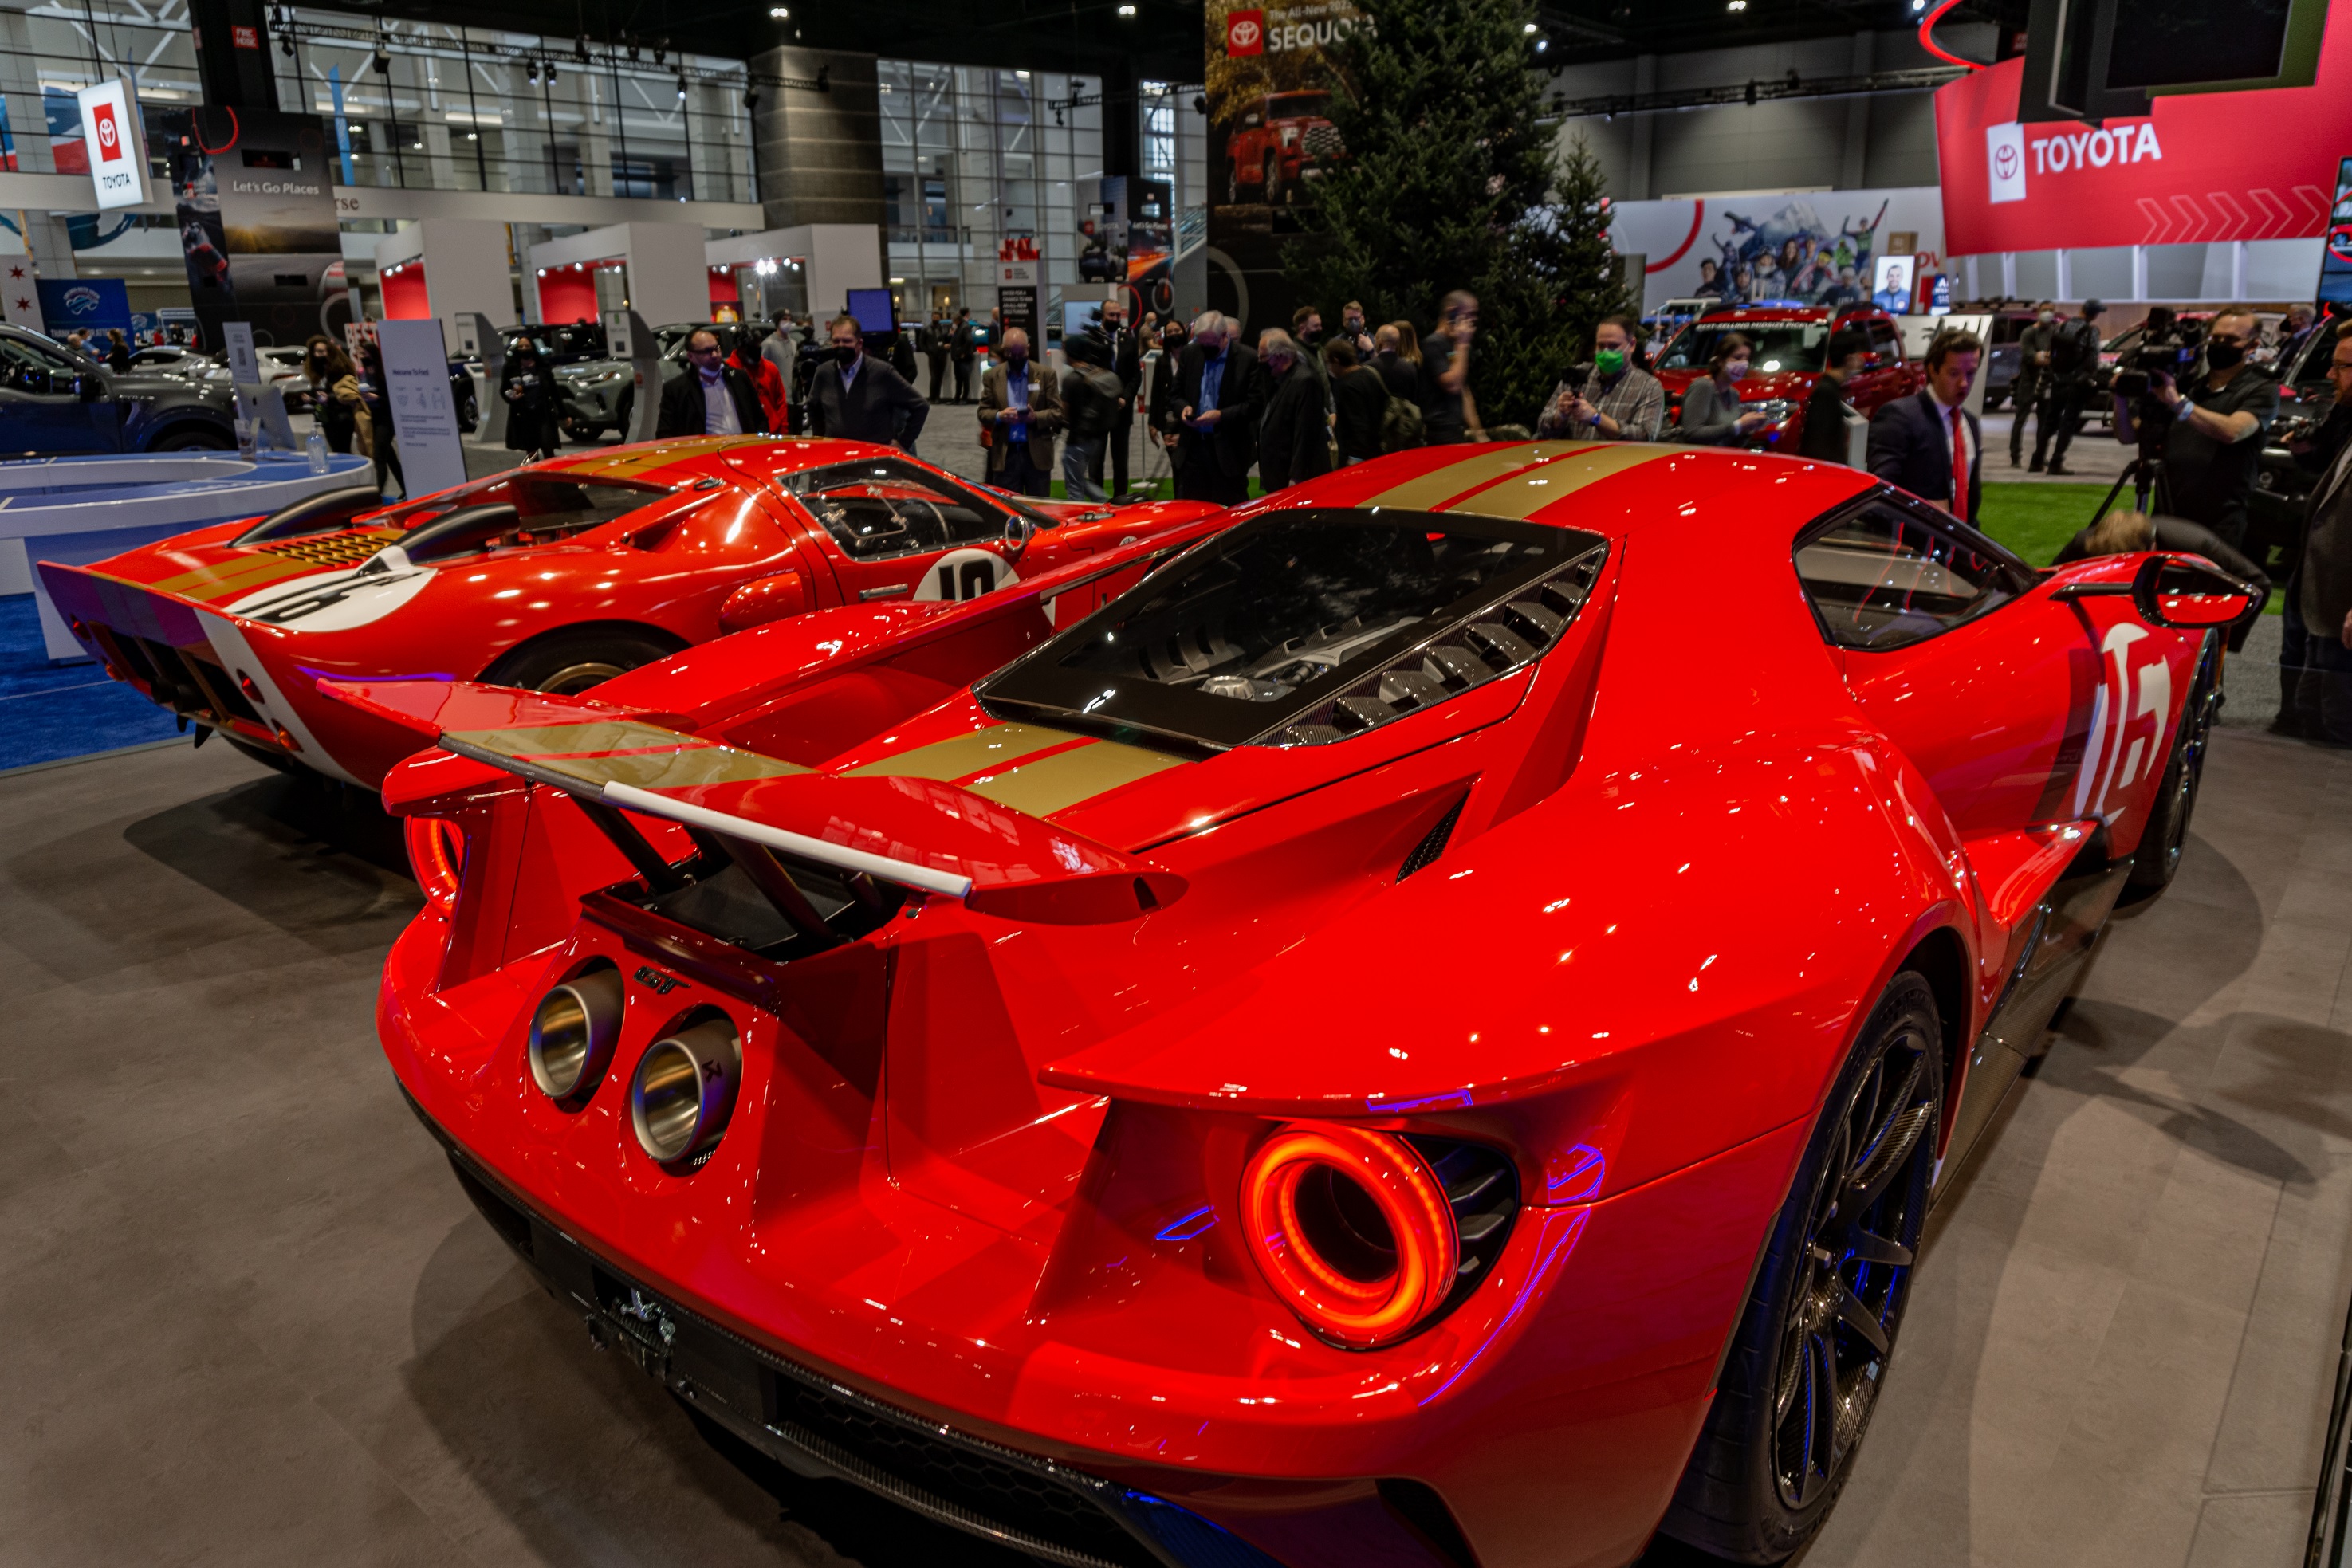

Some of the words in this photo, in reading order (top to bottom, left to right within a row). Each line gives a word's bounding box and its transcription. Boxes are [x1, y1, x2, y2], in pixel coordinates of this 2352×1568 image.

[1269, 10, 1286, 20] The
[1288, 6, 1327, 19] All-New
[2031, 122, 2162, 175] TOYOTA
[102, 172, 132, 190] TOYOTA
[262, 182, 280, 194] Go
[282, 183, 320, 196] Places
[1696, 322, 1749, 332] BEST-SELLING
[633, 965, 691, 996] GT
